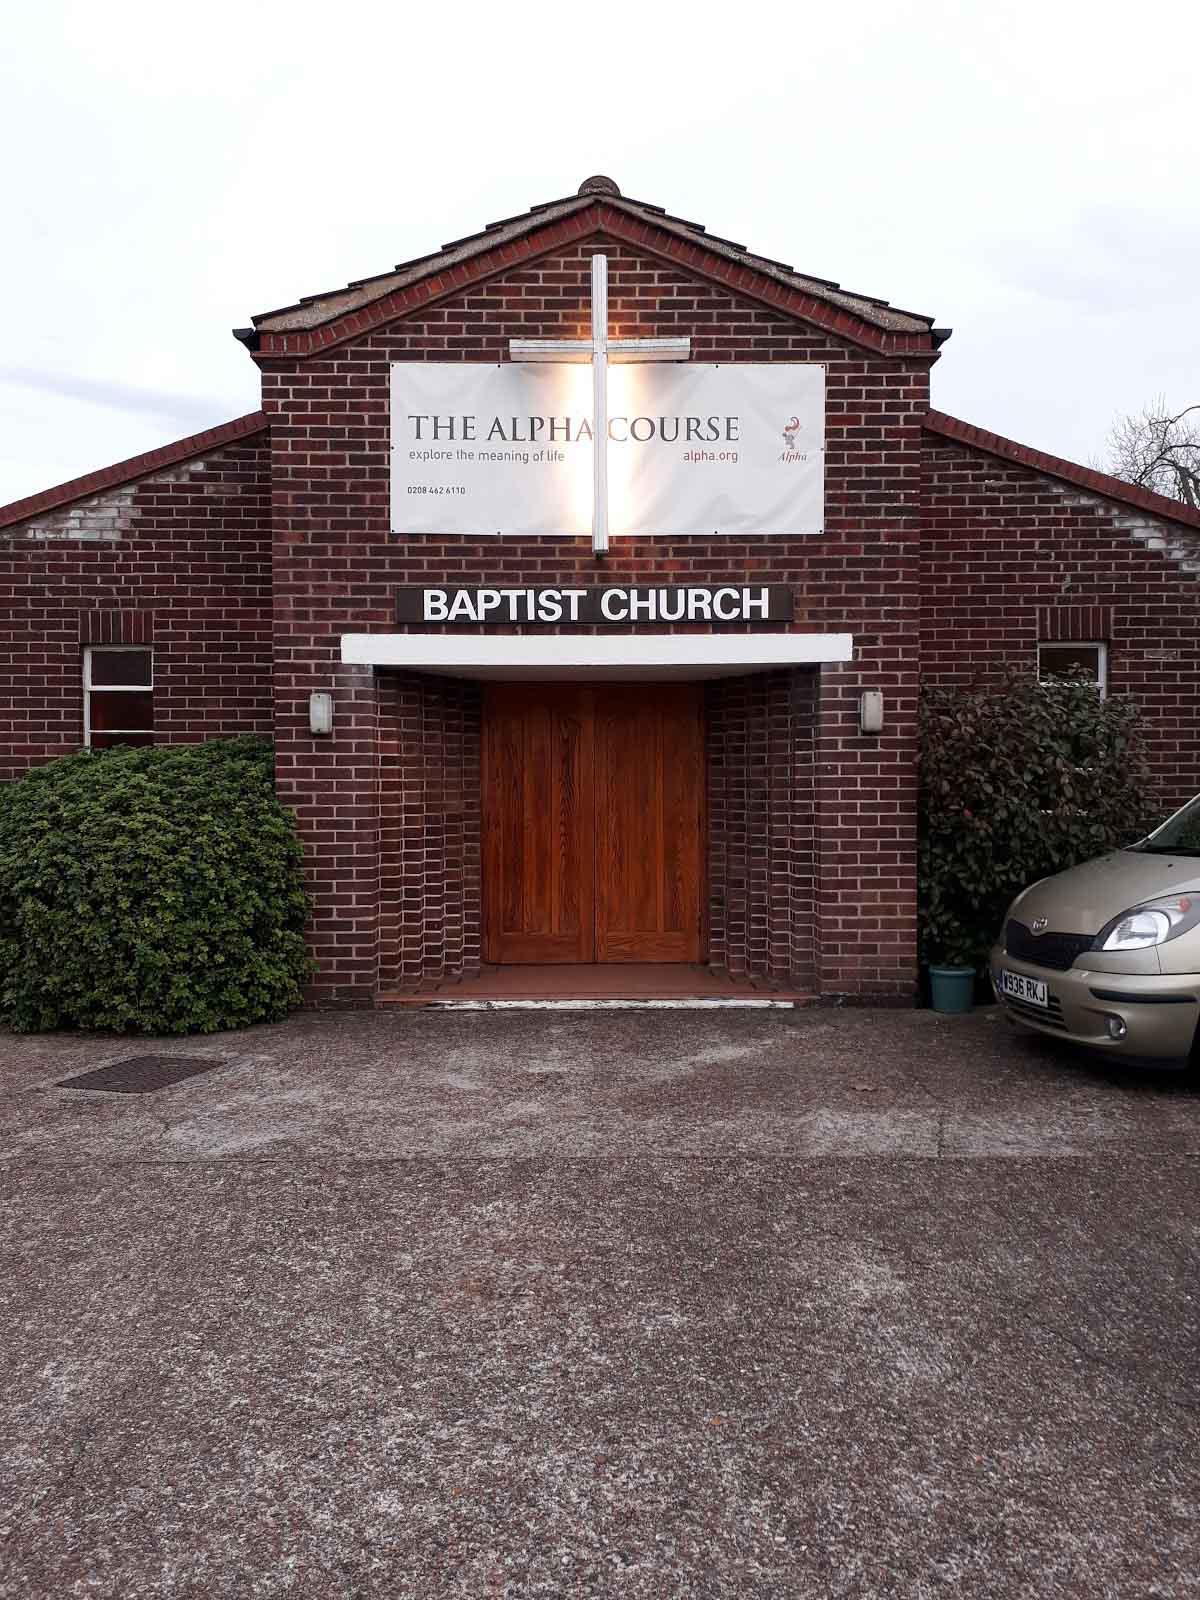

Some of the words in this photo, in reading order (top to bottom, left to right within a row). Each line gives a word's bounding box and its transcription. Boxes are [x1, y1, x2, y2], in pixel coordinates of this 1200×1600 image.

[407, 415, 476, 441] THE
[487, 416, 594, 442] ALPHA
[607, 416, 740, 442] COURSE
[408, 448, 453, 462] explore
[456, 449, 475, 460] the
[478, 449, 529, 464] meaning
[532, 450, 545, 462] of
[546, 450, 566, 462] life
[683, 450, 738, 463] alpha.org
[777, 451, 808, 462] Alpha
[407, 486, 427, 494] 0208
[429, 486, 444, 494] 462
[446, 486, 466, 494] 6110
[423, 589, 587, 622] BAPTIST
[600, 587, 770, 621] CHURCH
[1026, 980, 1045, 1002] RKJ
